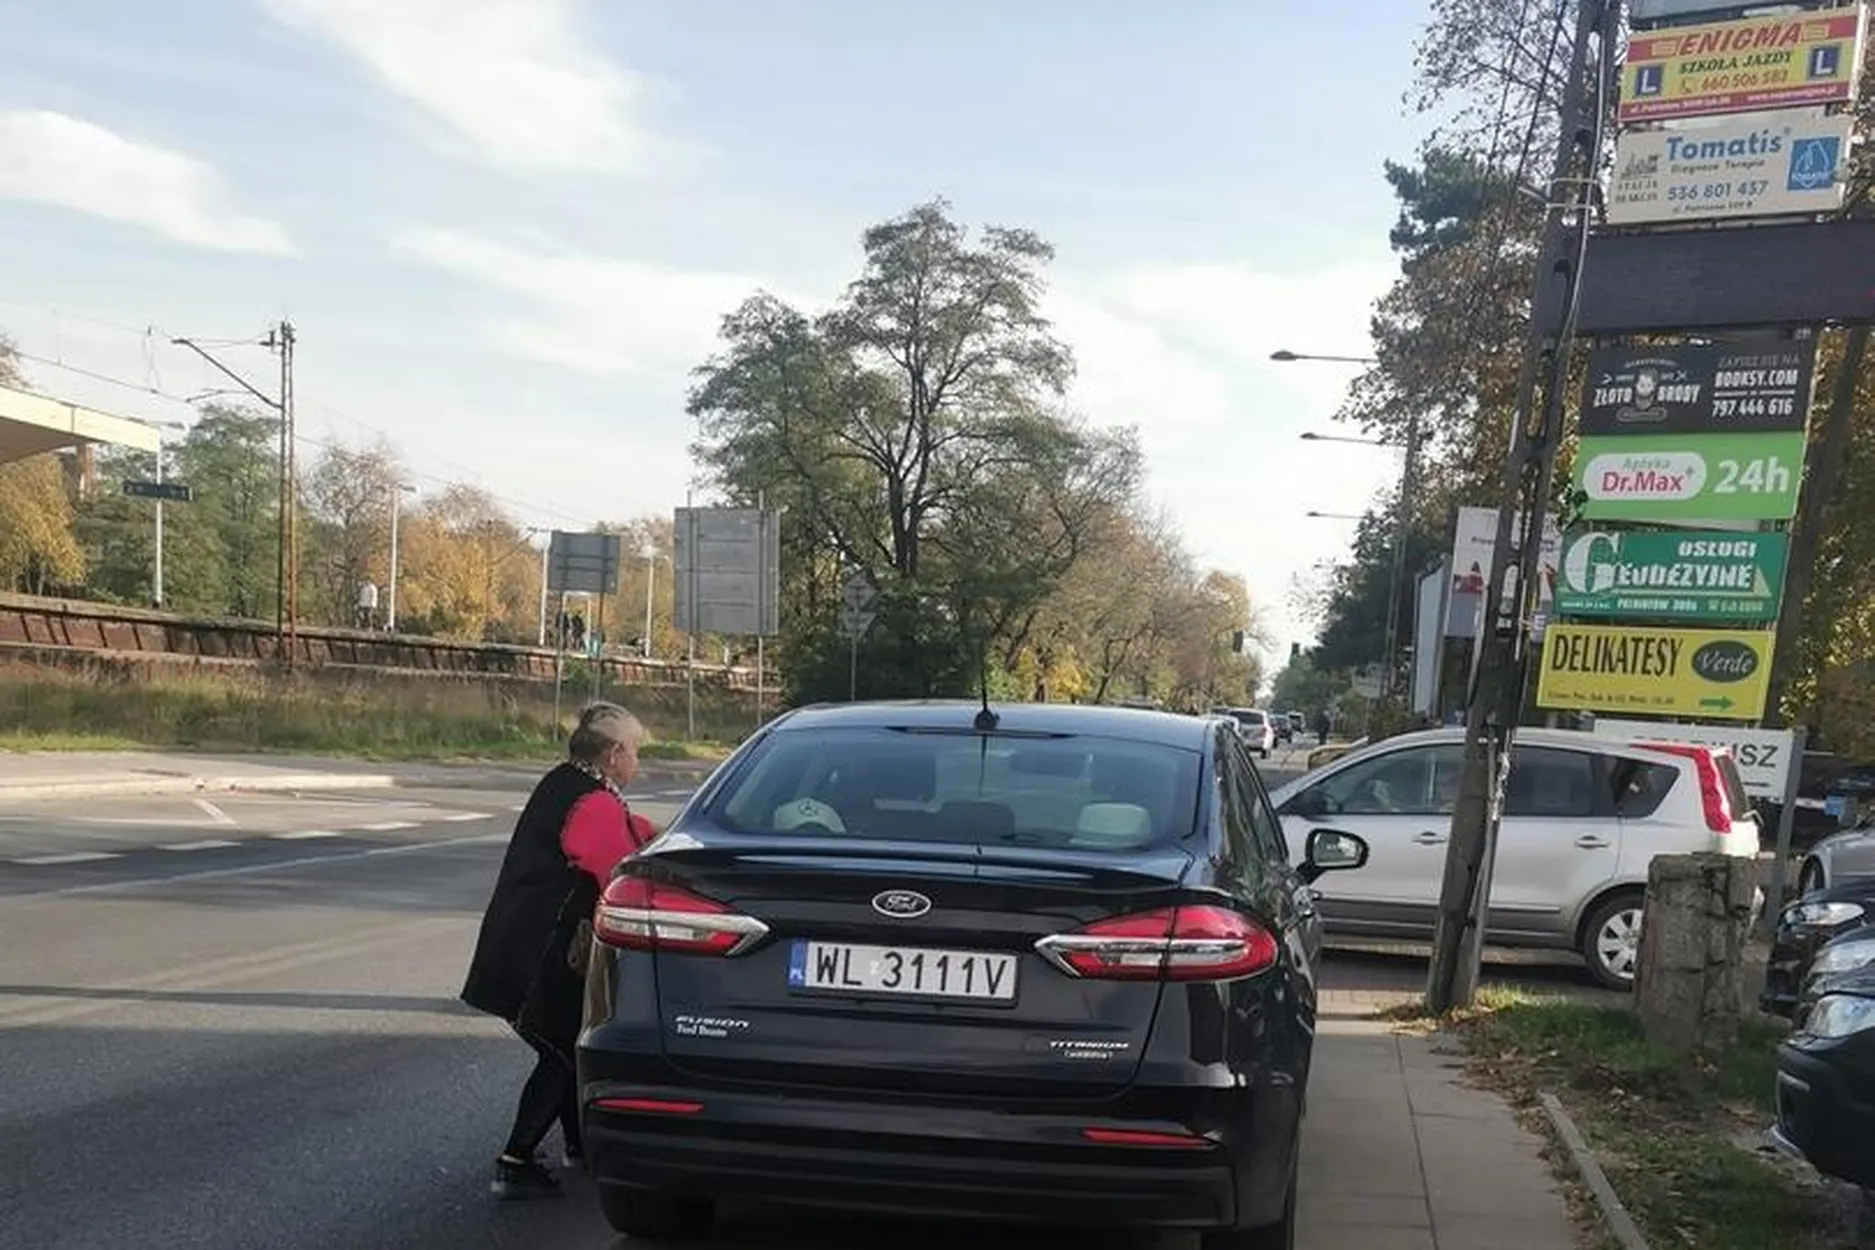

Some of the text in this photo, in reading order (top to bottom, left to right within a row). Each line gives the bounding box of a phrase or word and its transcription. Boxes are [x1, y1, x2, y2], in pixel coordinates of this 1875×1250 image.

[1677, 23, 1801, 56] ENIGMA
[1815, 50, 1833, 75] L
[1640, 69, 1657, 93] L
[1666, 129, 1782, 161] Tomatis
[1714, 370, 1798, 388] BOOKSY.COM
[1767, 397, 1793, 415] 616
[1602, 471, 1683, 493] Dr.Max
[1714, 456, 1789, 493] 24h
[1552, 634, 1683, 677] DELIKATESY
[816, 947, 1007, 995] WL 3111V
[675, 1015, 749, 1028] FUSION
